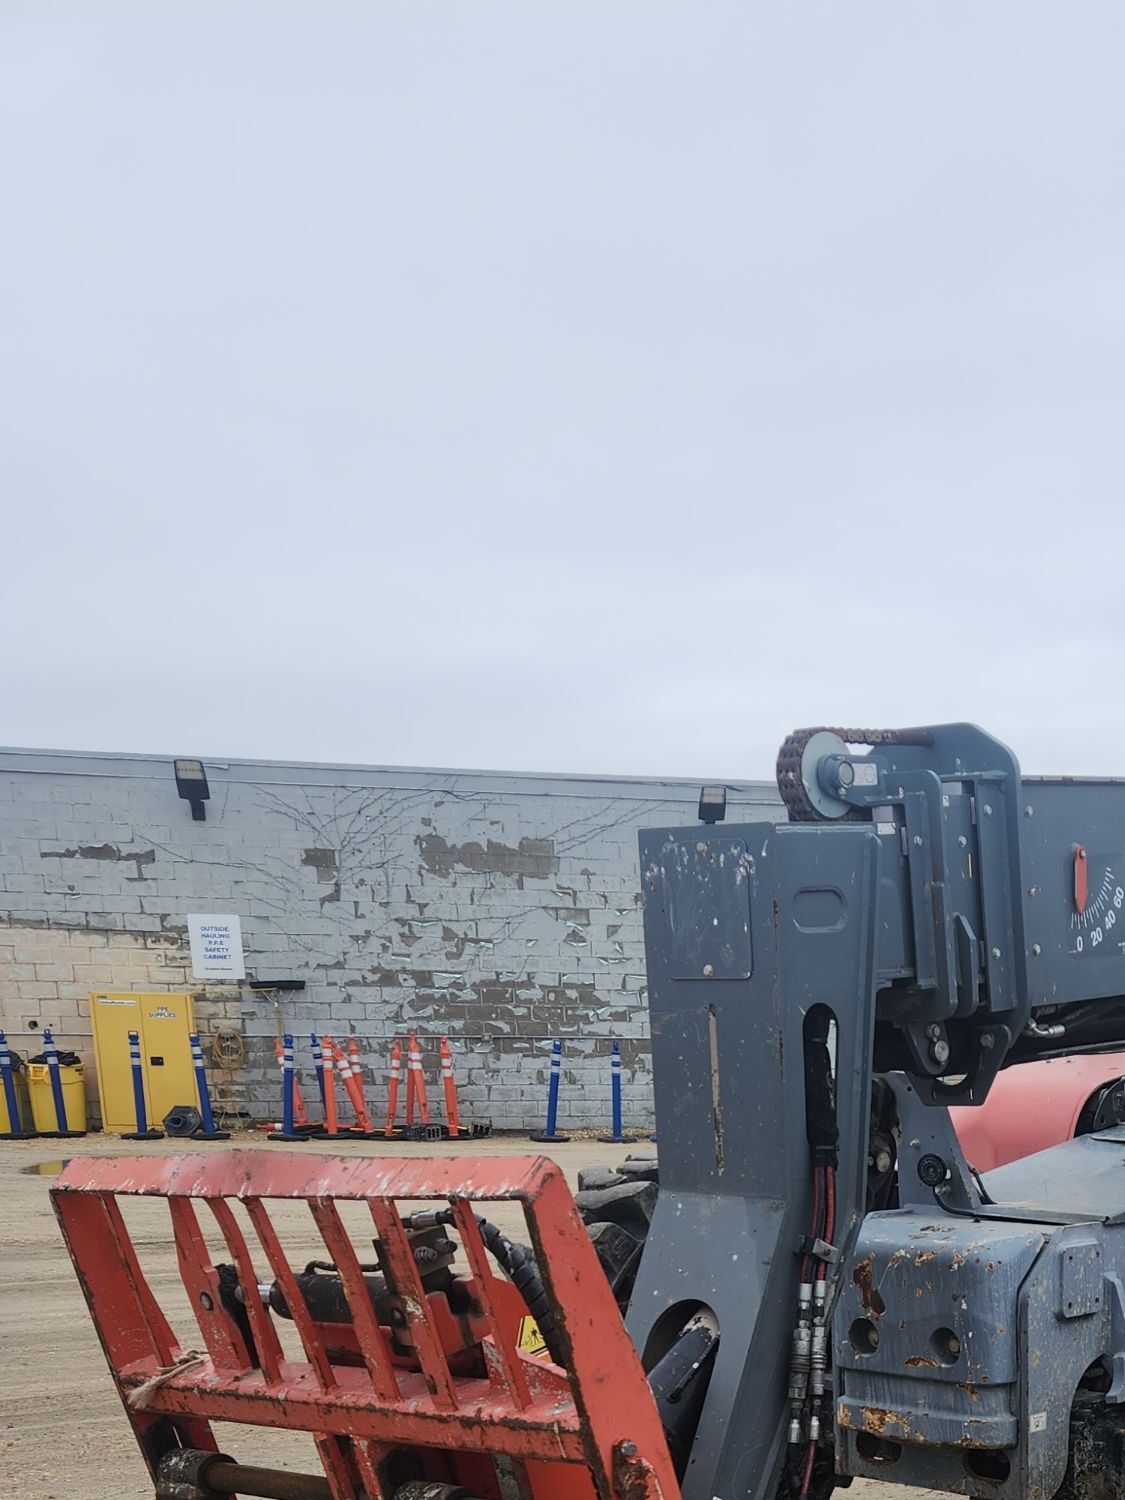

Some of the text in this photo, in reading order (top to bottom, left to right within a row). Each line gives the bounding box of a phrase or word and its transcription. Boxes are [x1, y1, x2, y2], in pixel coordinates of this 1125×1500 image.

[1113, 886, 1124, 908] 60
[1104, 909, 1116, 930] 40
[1076, 935, 1083, 952] 0
[1090, 926, 1103, 947] 20
